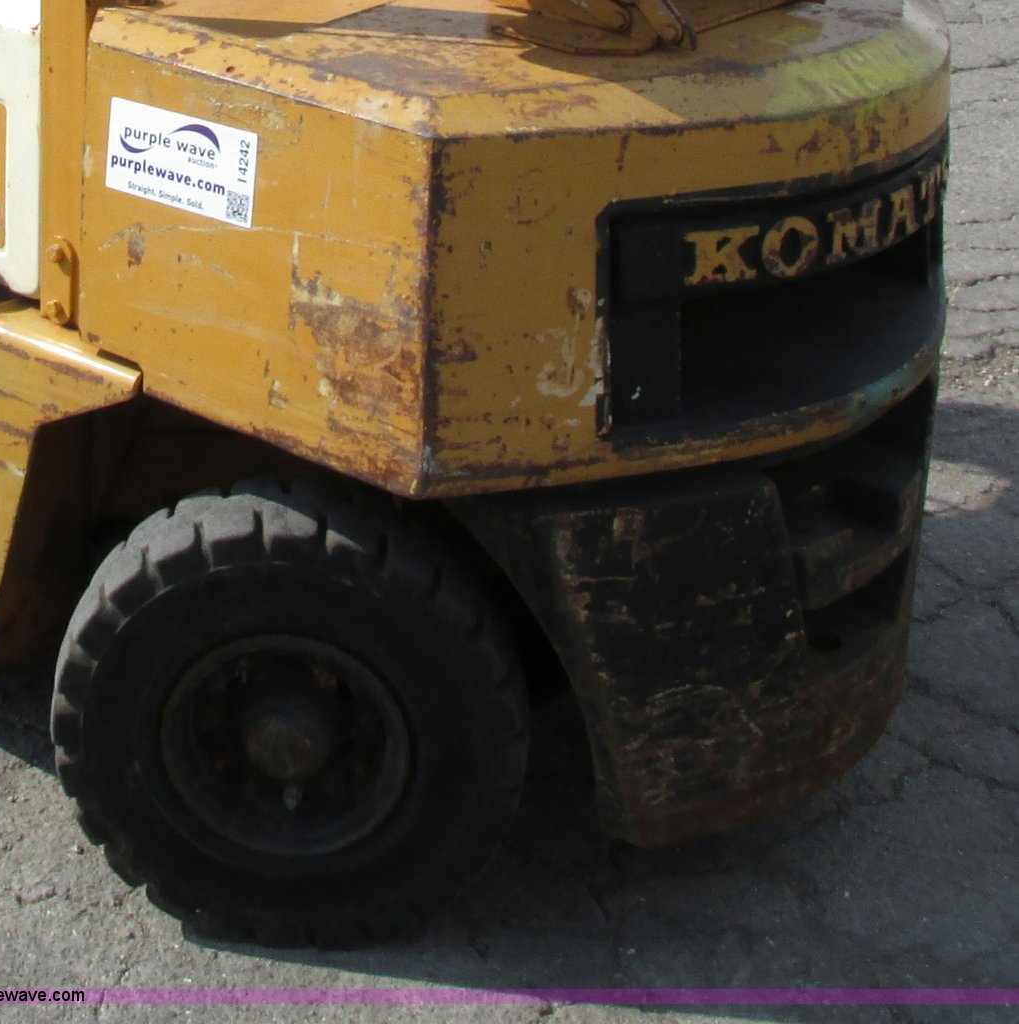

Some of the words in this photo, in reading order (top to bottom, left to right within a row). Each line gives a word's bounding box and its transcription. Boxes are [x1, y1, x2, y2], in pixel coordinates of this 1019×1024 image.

[124, 126, 171, 148] purple
[177, 140, 216, 160] wave
[237, 139, 251, 184] 14242
[111, 154, 226, 196] purplewave.com
[127, 180, 157, 197] Straight.
[159, 189, 184, 205] Simple.
[186, 198, 204, 210] Sold.
[684, 157, 949, 286] KOMAT
